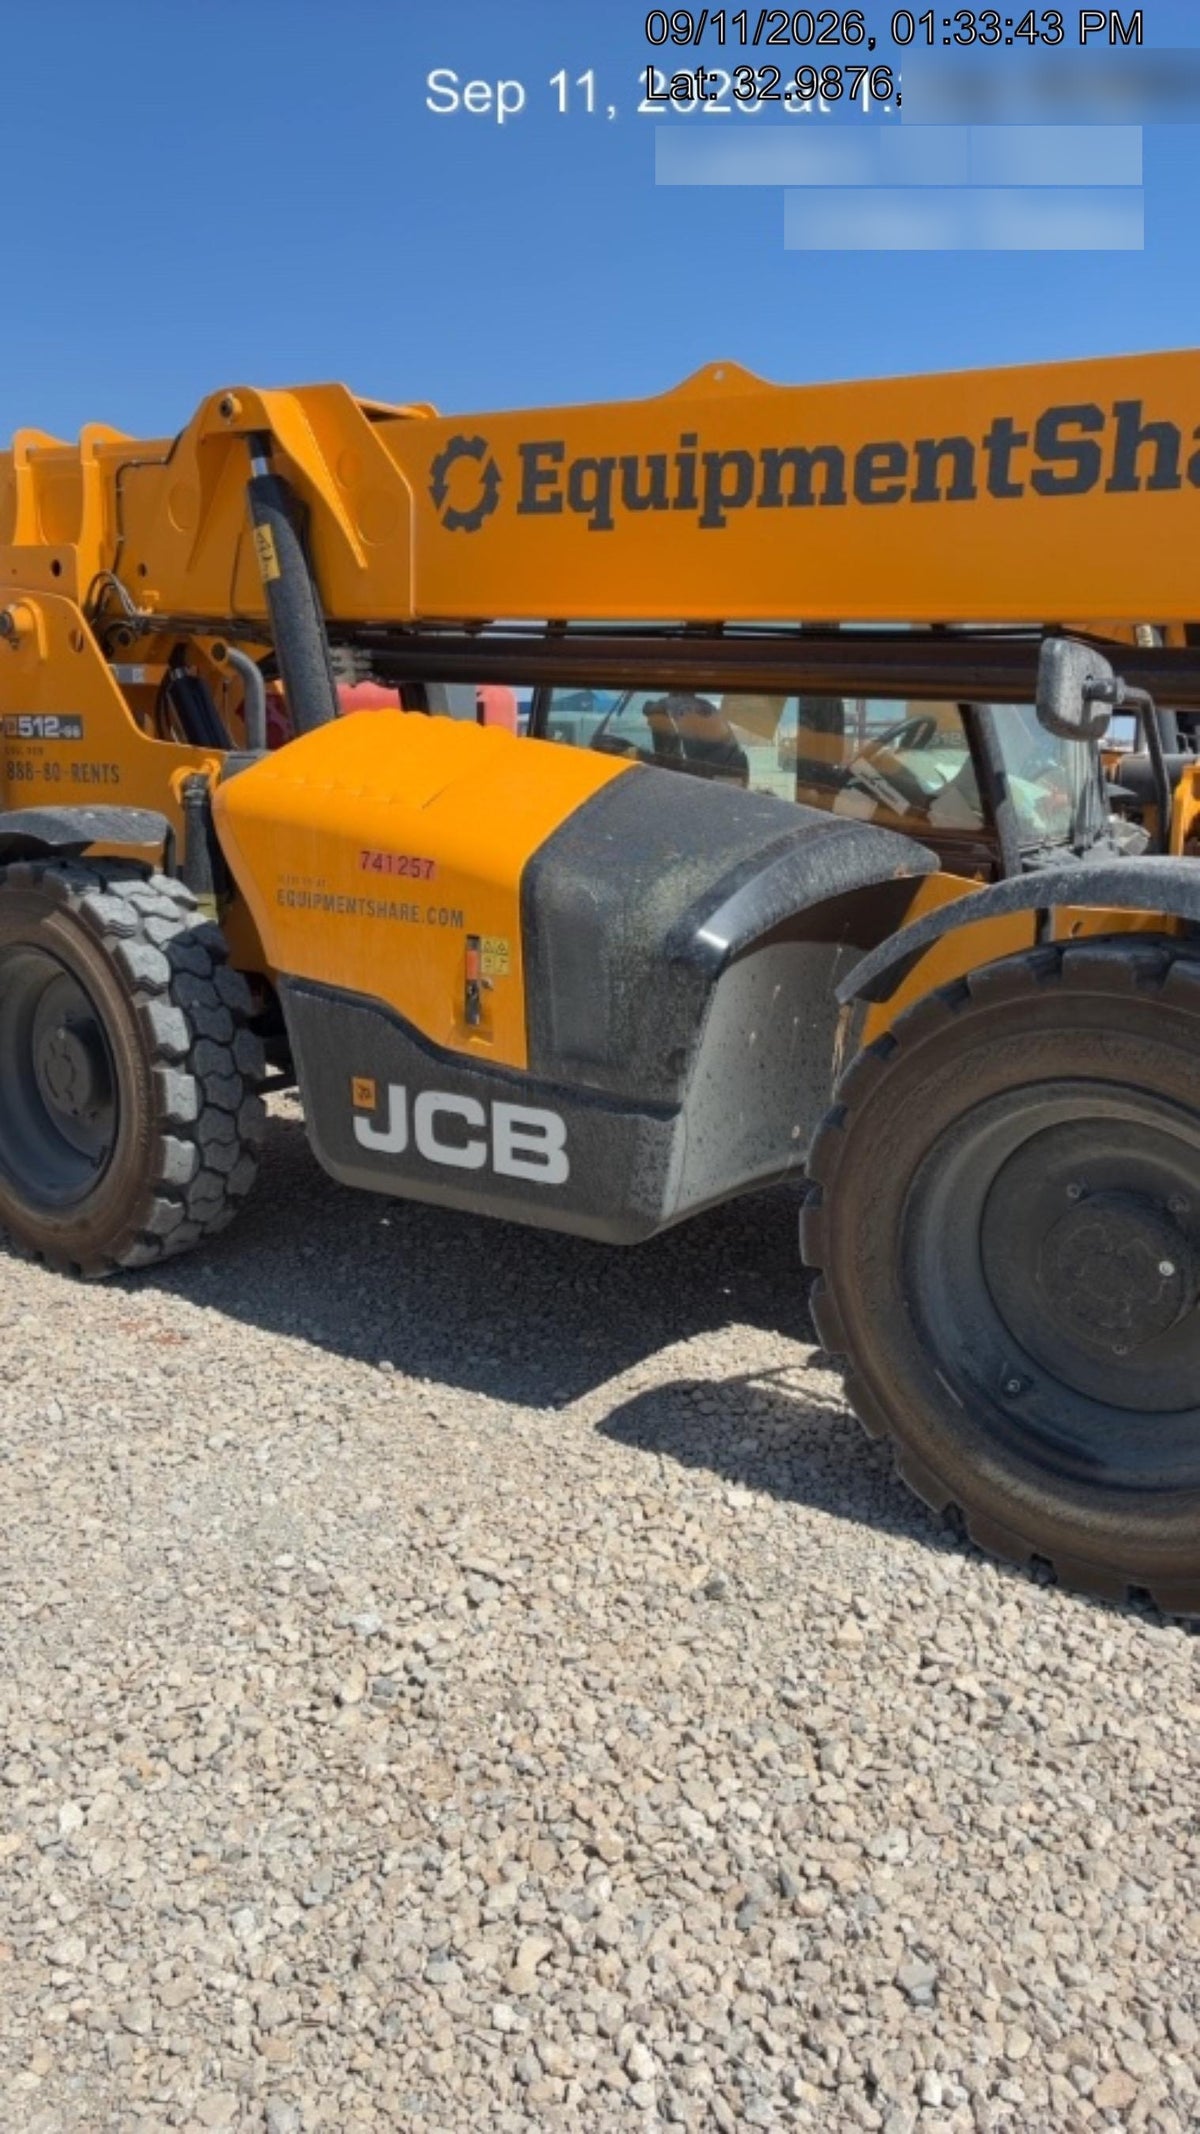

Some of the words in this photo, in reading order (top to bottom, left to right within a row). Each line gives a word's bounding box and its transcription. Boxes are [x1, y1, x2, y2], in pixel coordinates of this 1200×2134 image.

[516, 400, 1200, 531] EquipmentSh
[360, 851, 435, 879] 741257
[277, 889, 464, 928] EQUIPMENTSHARE.COM
[353, 1084, 569, 1184] JCB
